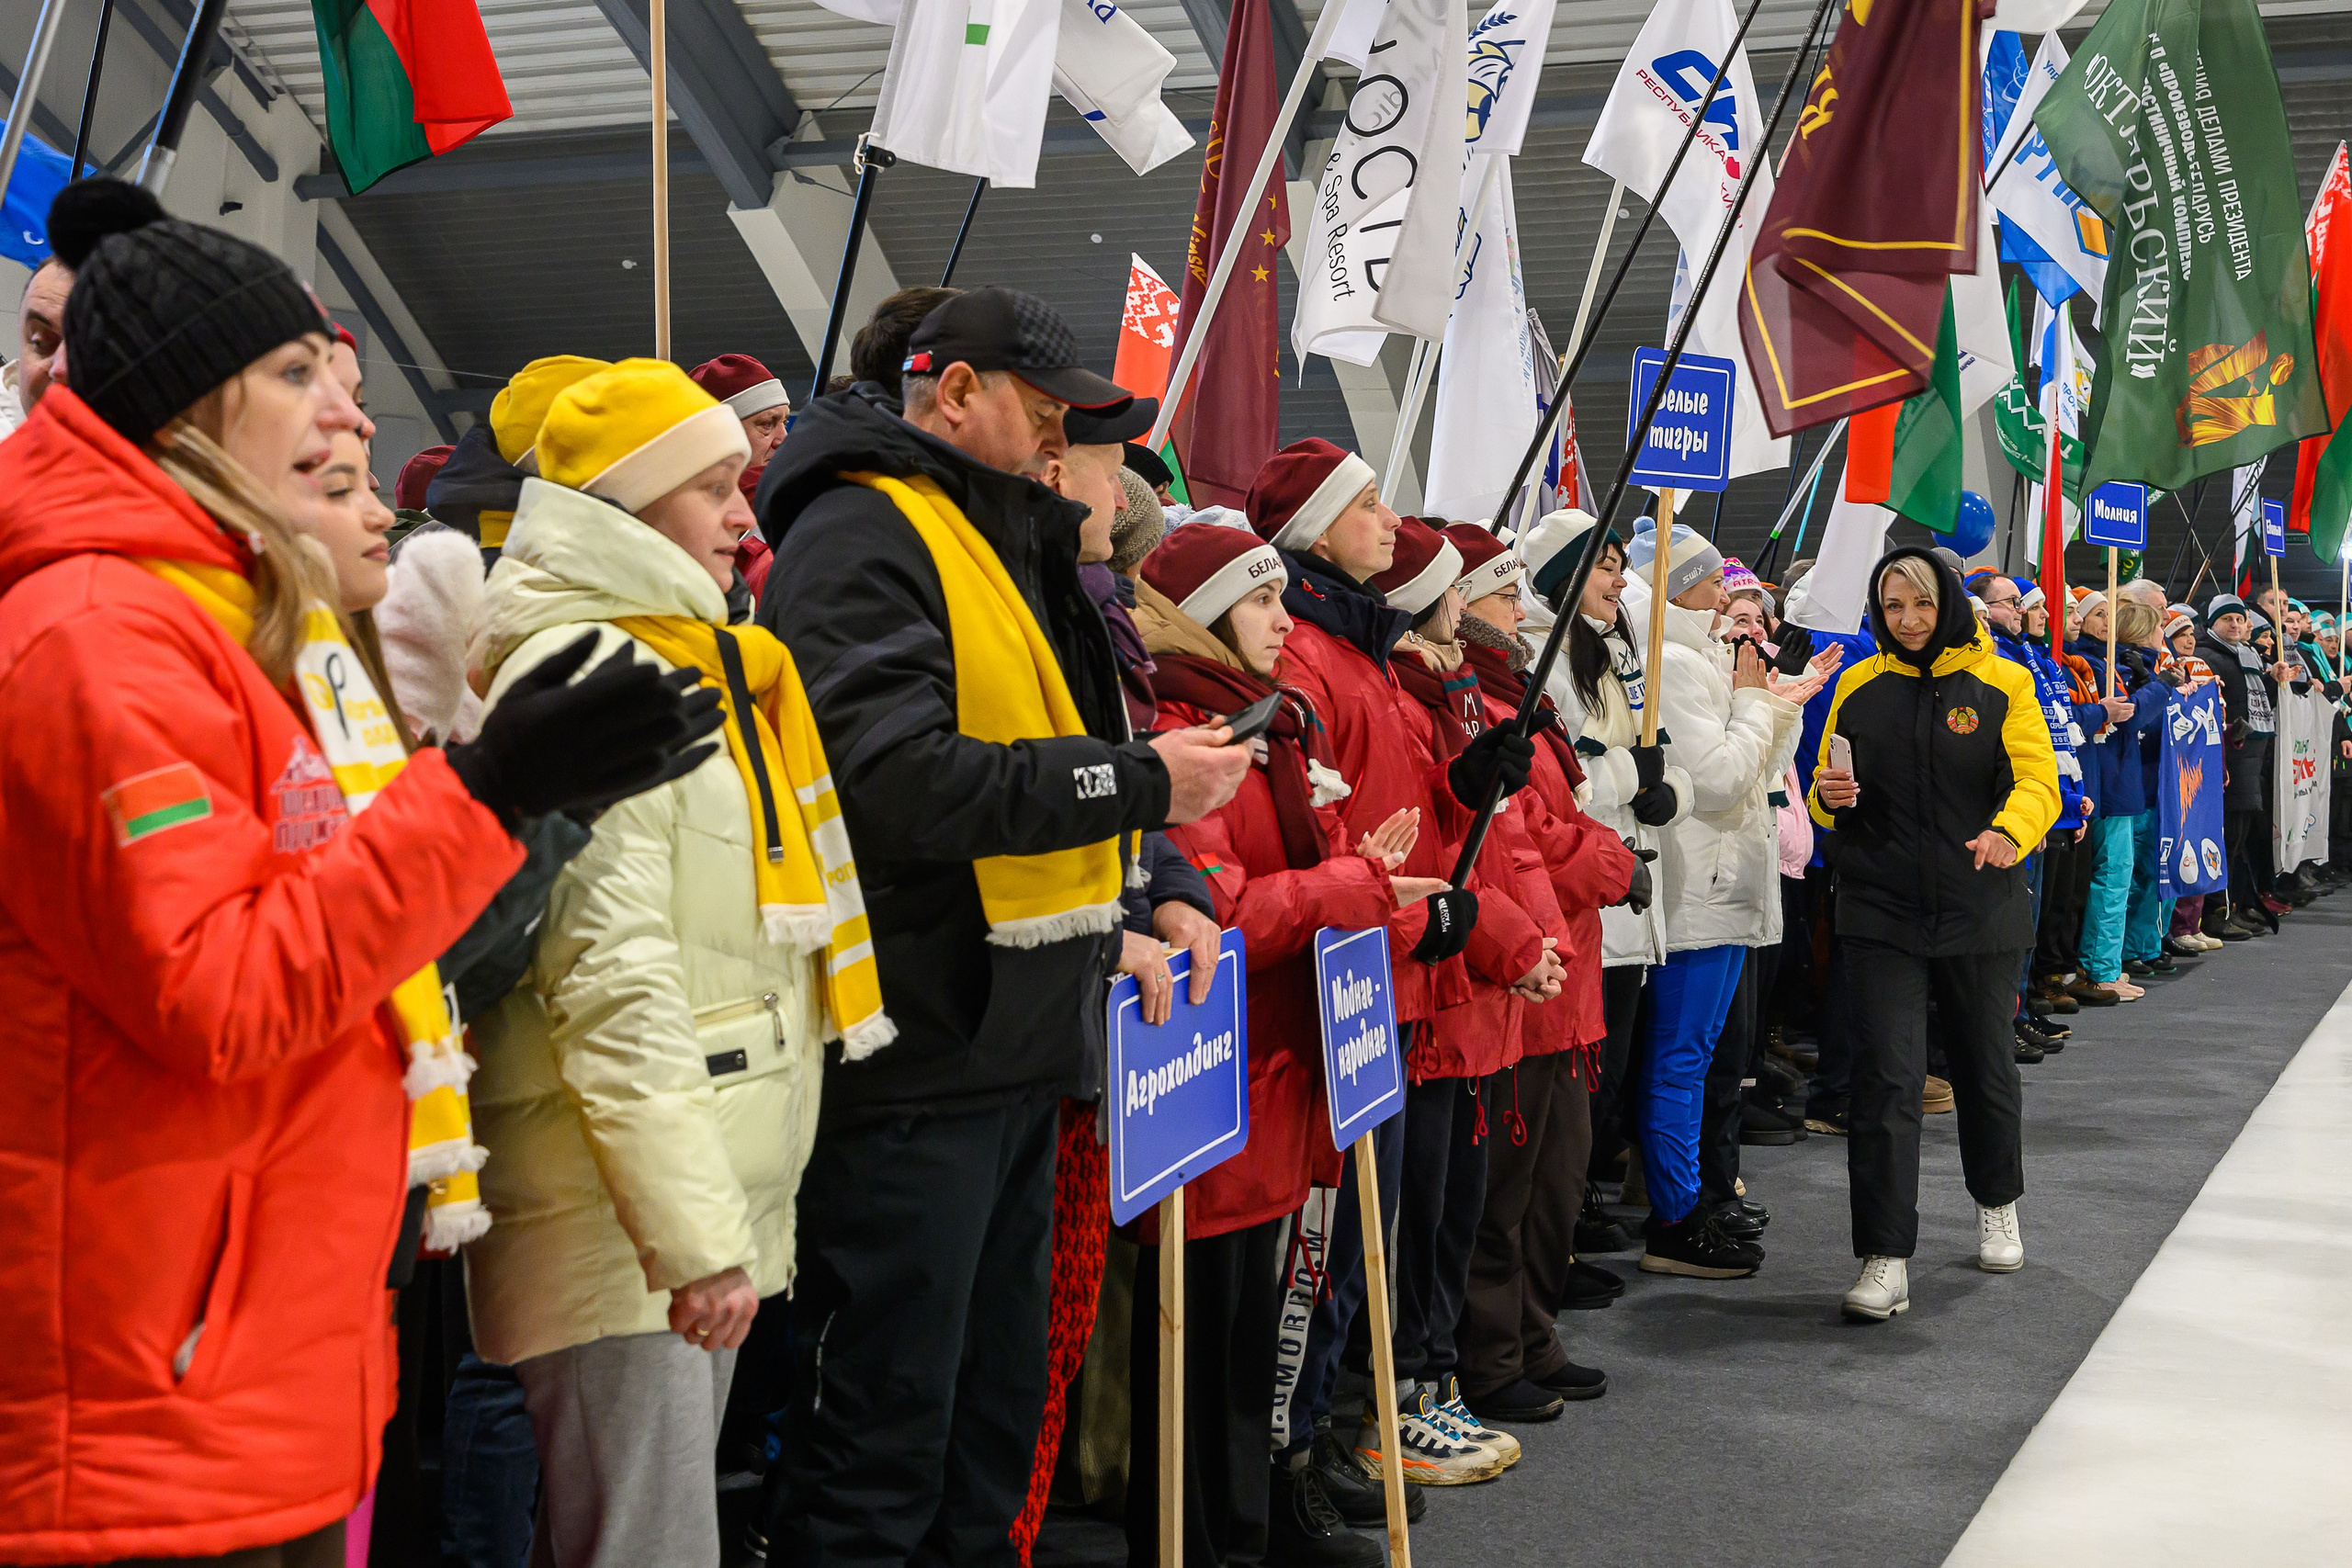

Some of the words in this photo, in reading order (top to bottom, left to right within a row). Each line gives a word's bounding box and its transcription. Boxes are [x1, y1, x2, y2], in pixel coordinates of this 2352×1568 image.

[1321, 175, 1342, 224] Spa
[2195, 105, 2233, 176] ДЕЛАМИ
[2217, 178, 2252, 281] ПРЕЗИДЕНТА
[1328, 222, 1355, 301] Resort
[1649, 425, 1709, 461] тигры
[2095, 498, 2138, 525] Молния
[1248, 556, 1282, 579] БЕЛА
[1493, 559, 1521, 579] БЕЛА
[1126, 1032, 1233, 1118] Агрохолдинг
[1338, 1018, 1387, 1086] народнае
